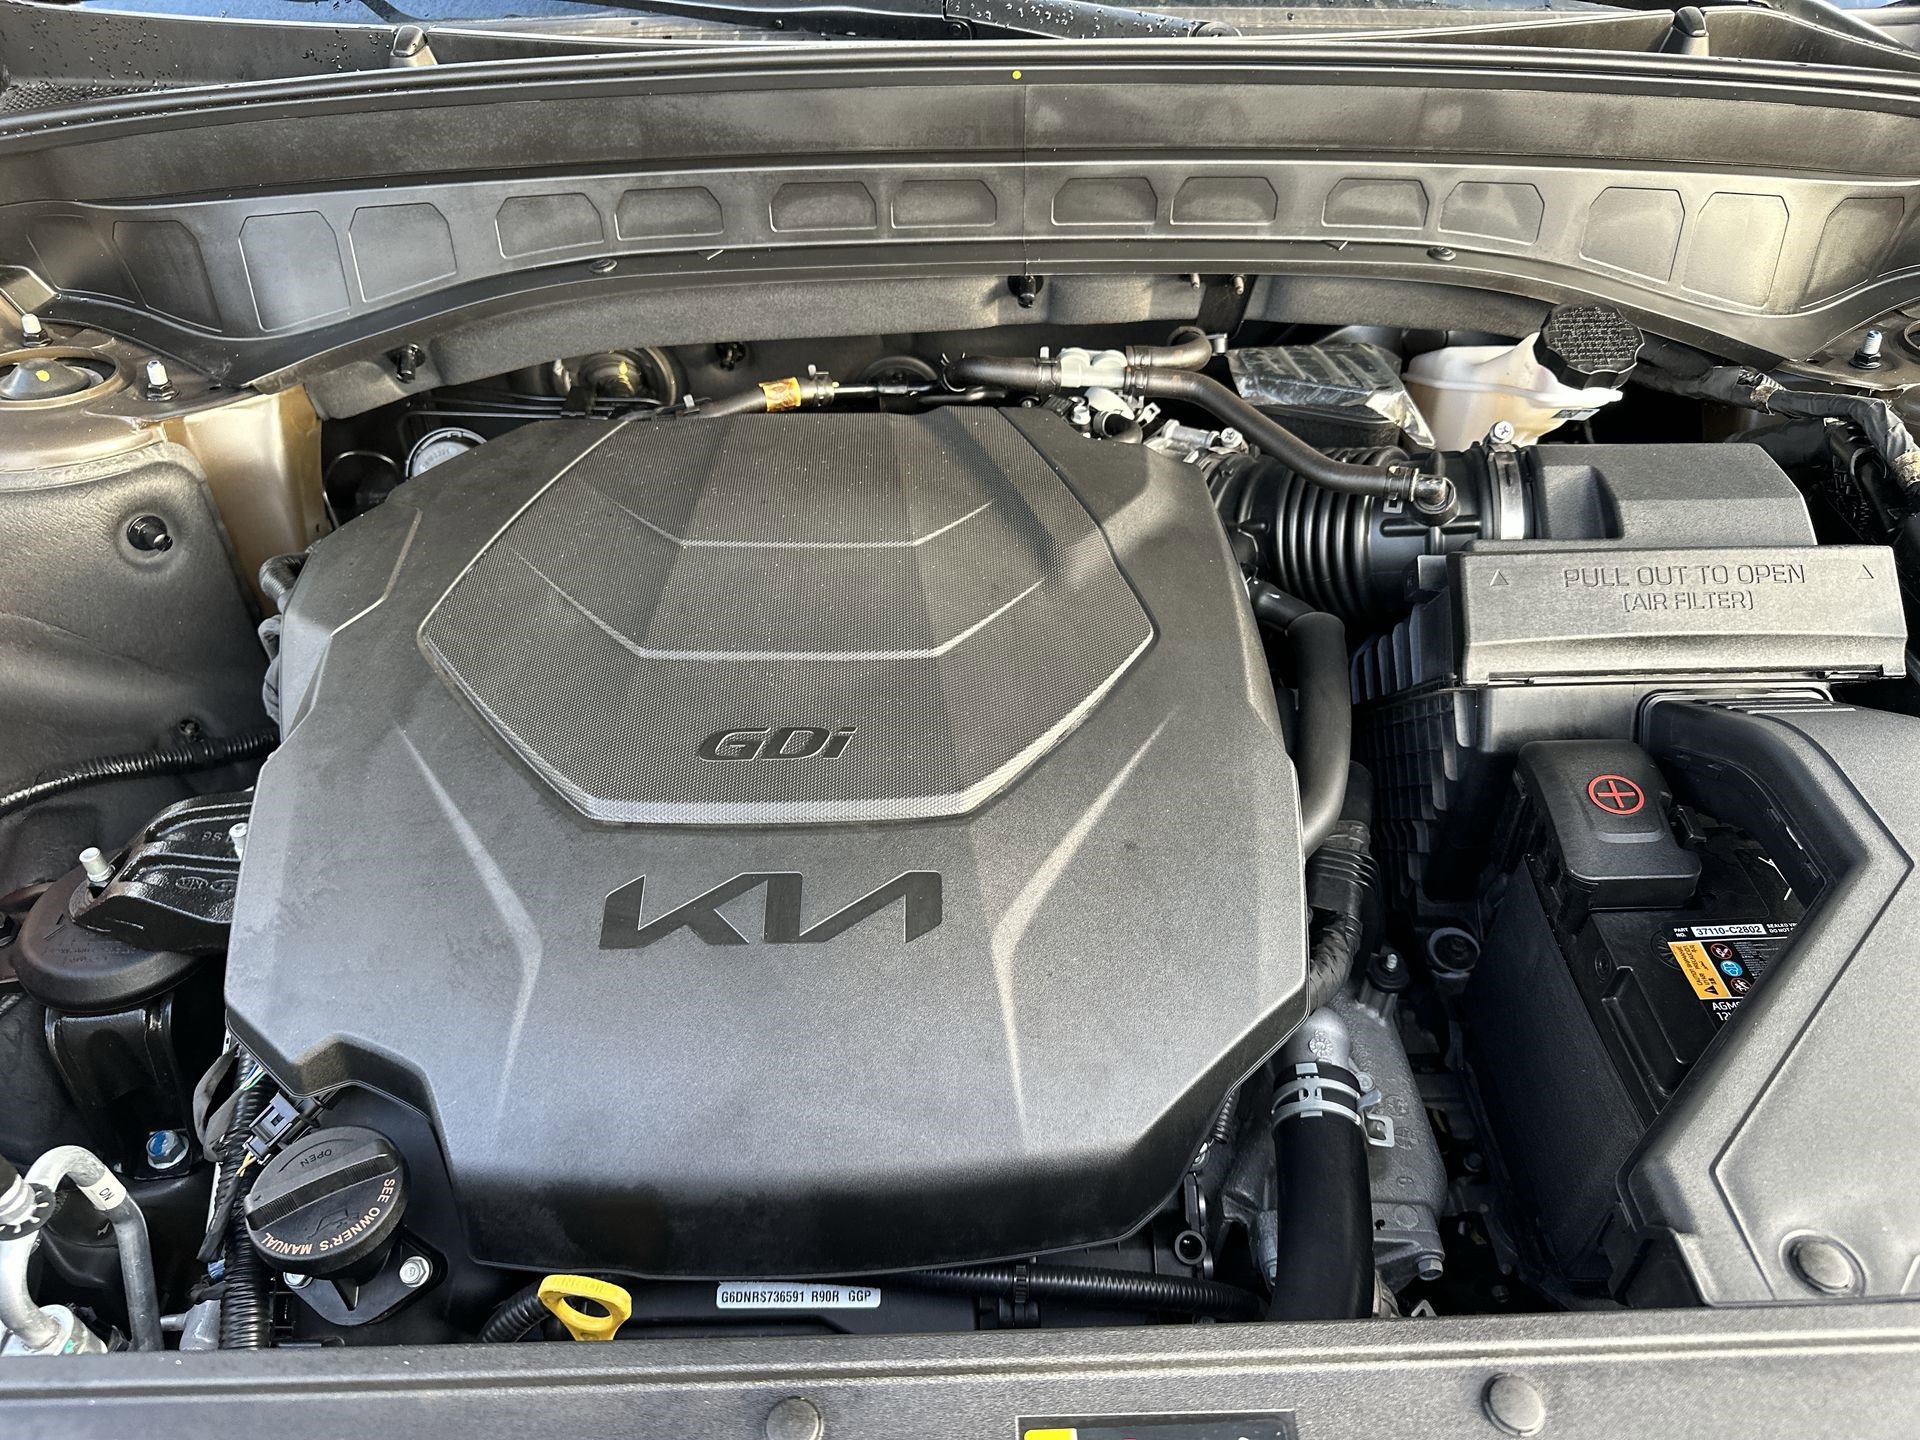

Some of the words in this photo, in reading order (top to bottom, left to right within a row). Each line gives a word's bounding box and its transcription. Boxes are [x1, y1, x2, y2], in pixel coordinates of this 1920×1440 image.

[1563, 566, 1630, 588] PULL
[1637, 565, 1688, 586] OUT
[1695, 564, 1729, 585] TO
[1737, 563, 1806, 584] OPEN
[699, 726, 858, 762] GDi
[599, 869, 943, 950] KIA
[1694, 926, 1763, 936] 37110-C2802
[300, 1149, 333, 1167] OPEN
[376, 1177, 396, 1204] SEE
[319, 1207, 381, 1251] OWNER'S
[261, 1232, 313, 1255] MANUAL
[721, 1291, 805, 1303] G6DNRS736591
[848, 1289, 872, 1302] GGP
